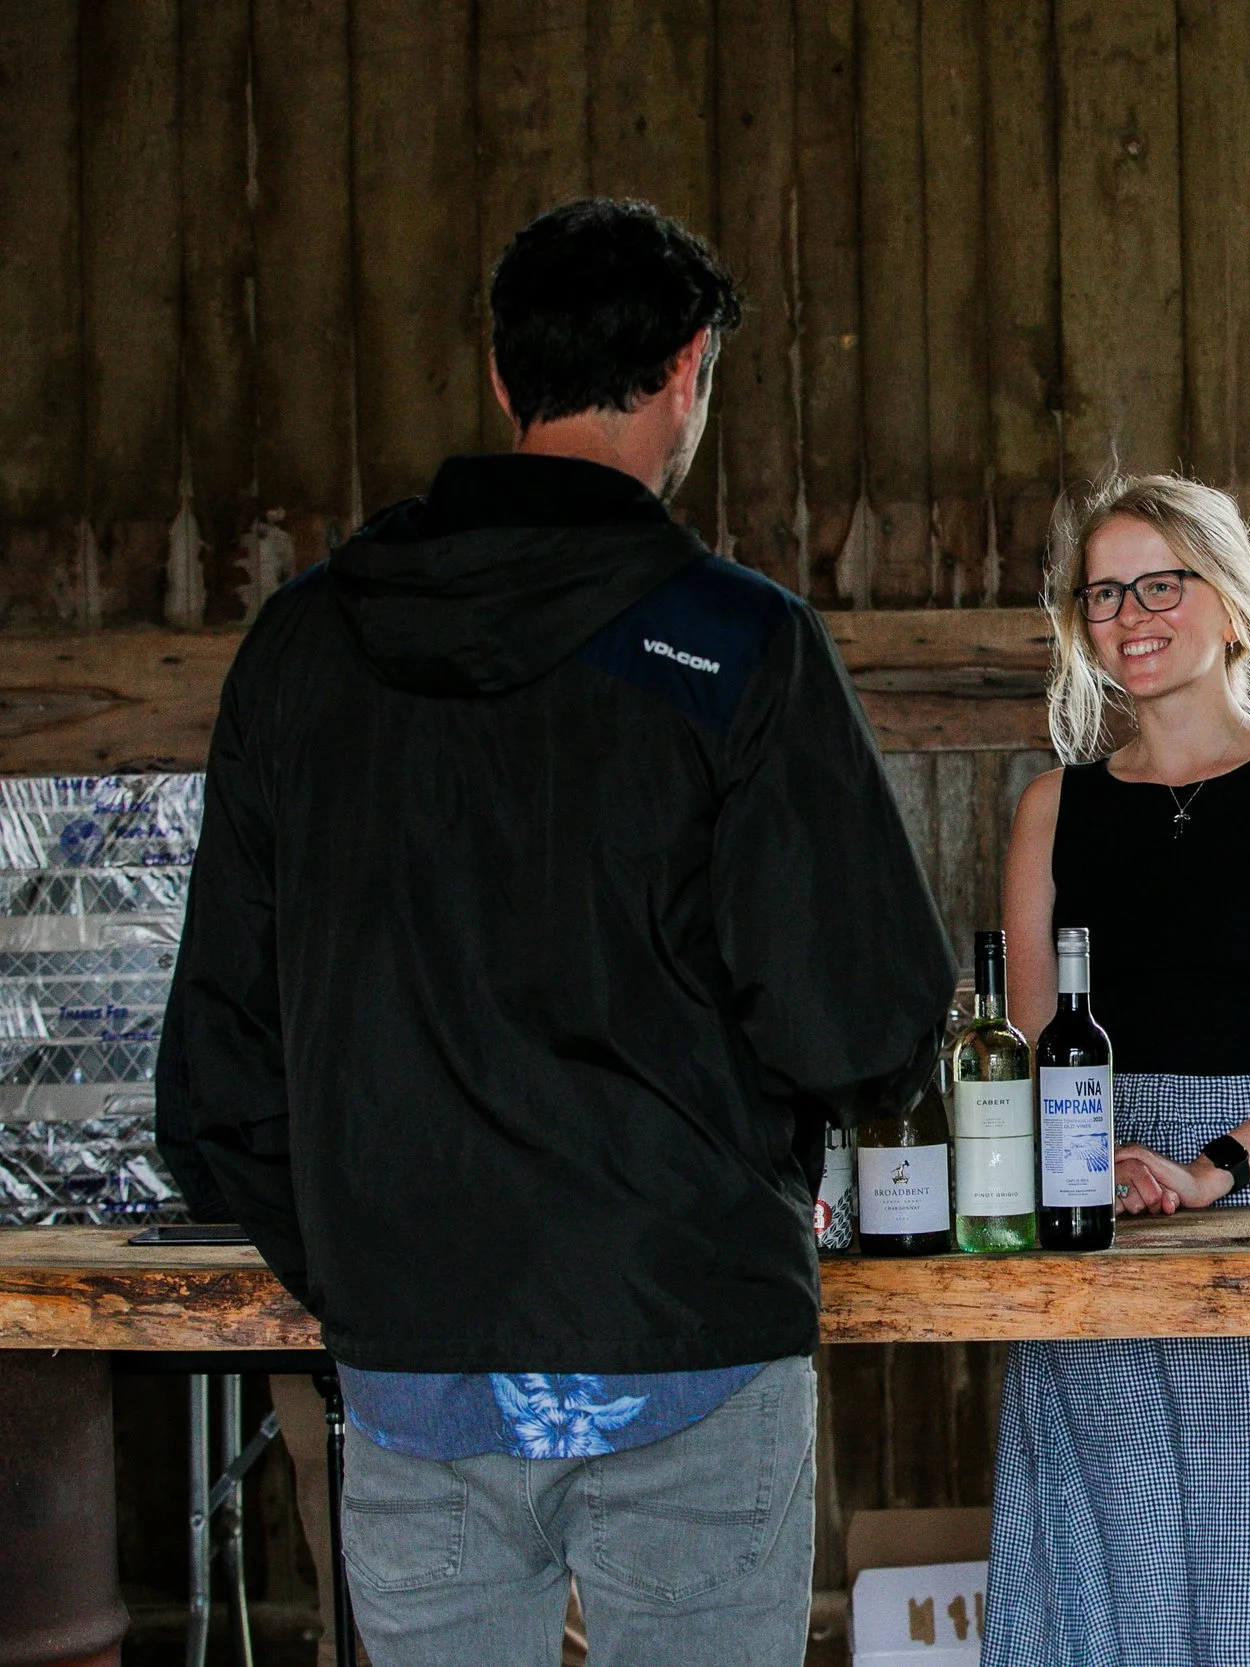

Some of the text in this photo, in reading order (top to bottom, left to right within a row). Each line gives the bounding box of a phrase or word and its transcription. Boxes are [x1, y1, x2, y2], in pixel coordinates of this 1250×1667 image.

[643, 638, 721, 675] VOLCOM
[1075, 1077, 1102, 1097] VIÑA
[976, 1098, 1010, 1106] CABERT
[1043, 1098, 1103, 1115] TEMPRANA
[874, 1186, 930, 1197] BROADBENT
